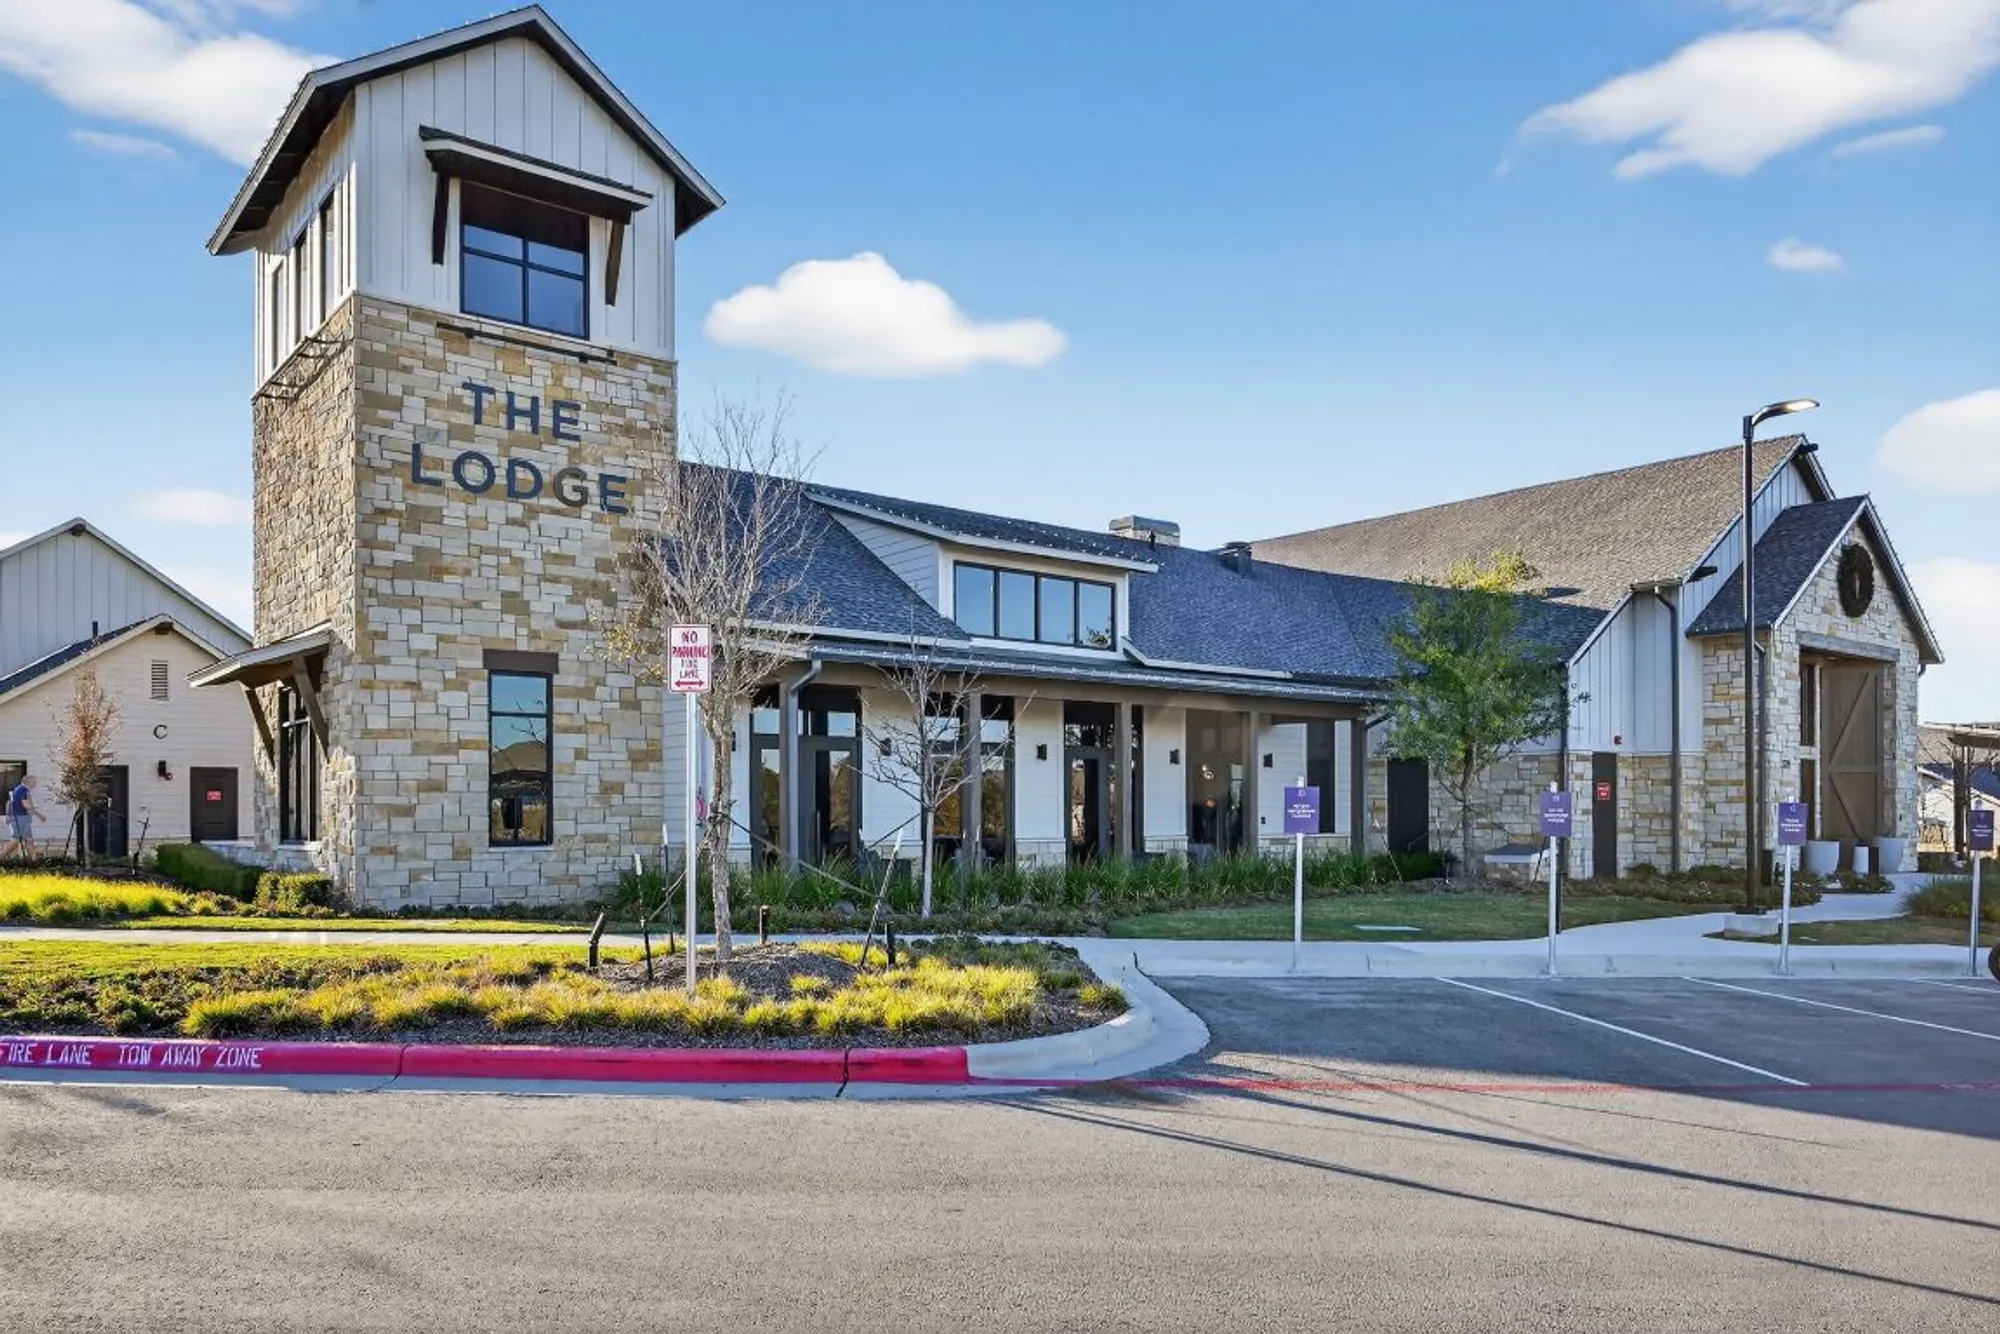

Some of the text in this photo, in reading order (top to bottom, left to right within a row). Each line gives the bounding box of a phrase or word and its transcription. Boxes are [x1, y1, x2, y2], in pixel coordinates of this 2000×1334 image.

[462, 381, 581, 442] THE
[412, 443, 628, 515] LODGE
[681, 630, 698, 644] NO
[153, 724, 168, 740] C
[45, 1043, 95, 1065] LANE
[118, 1044, 153, 1066] TOW
[161, 1045, 207, 1068] AWAY
[214, 1046, 264, 1069] ZONE
